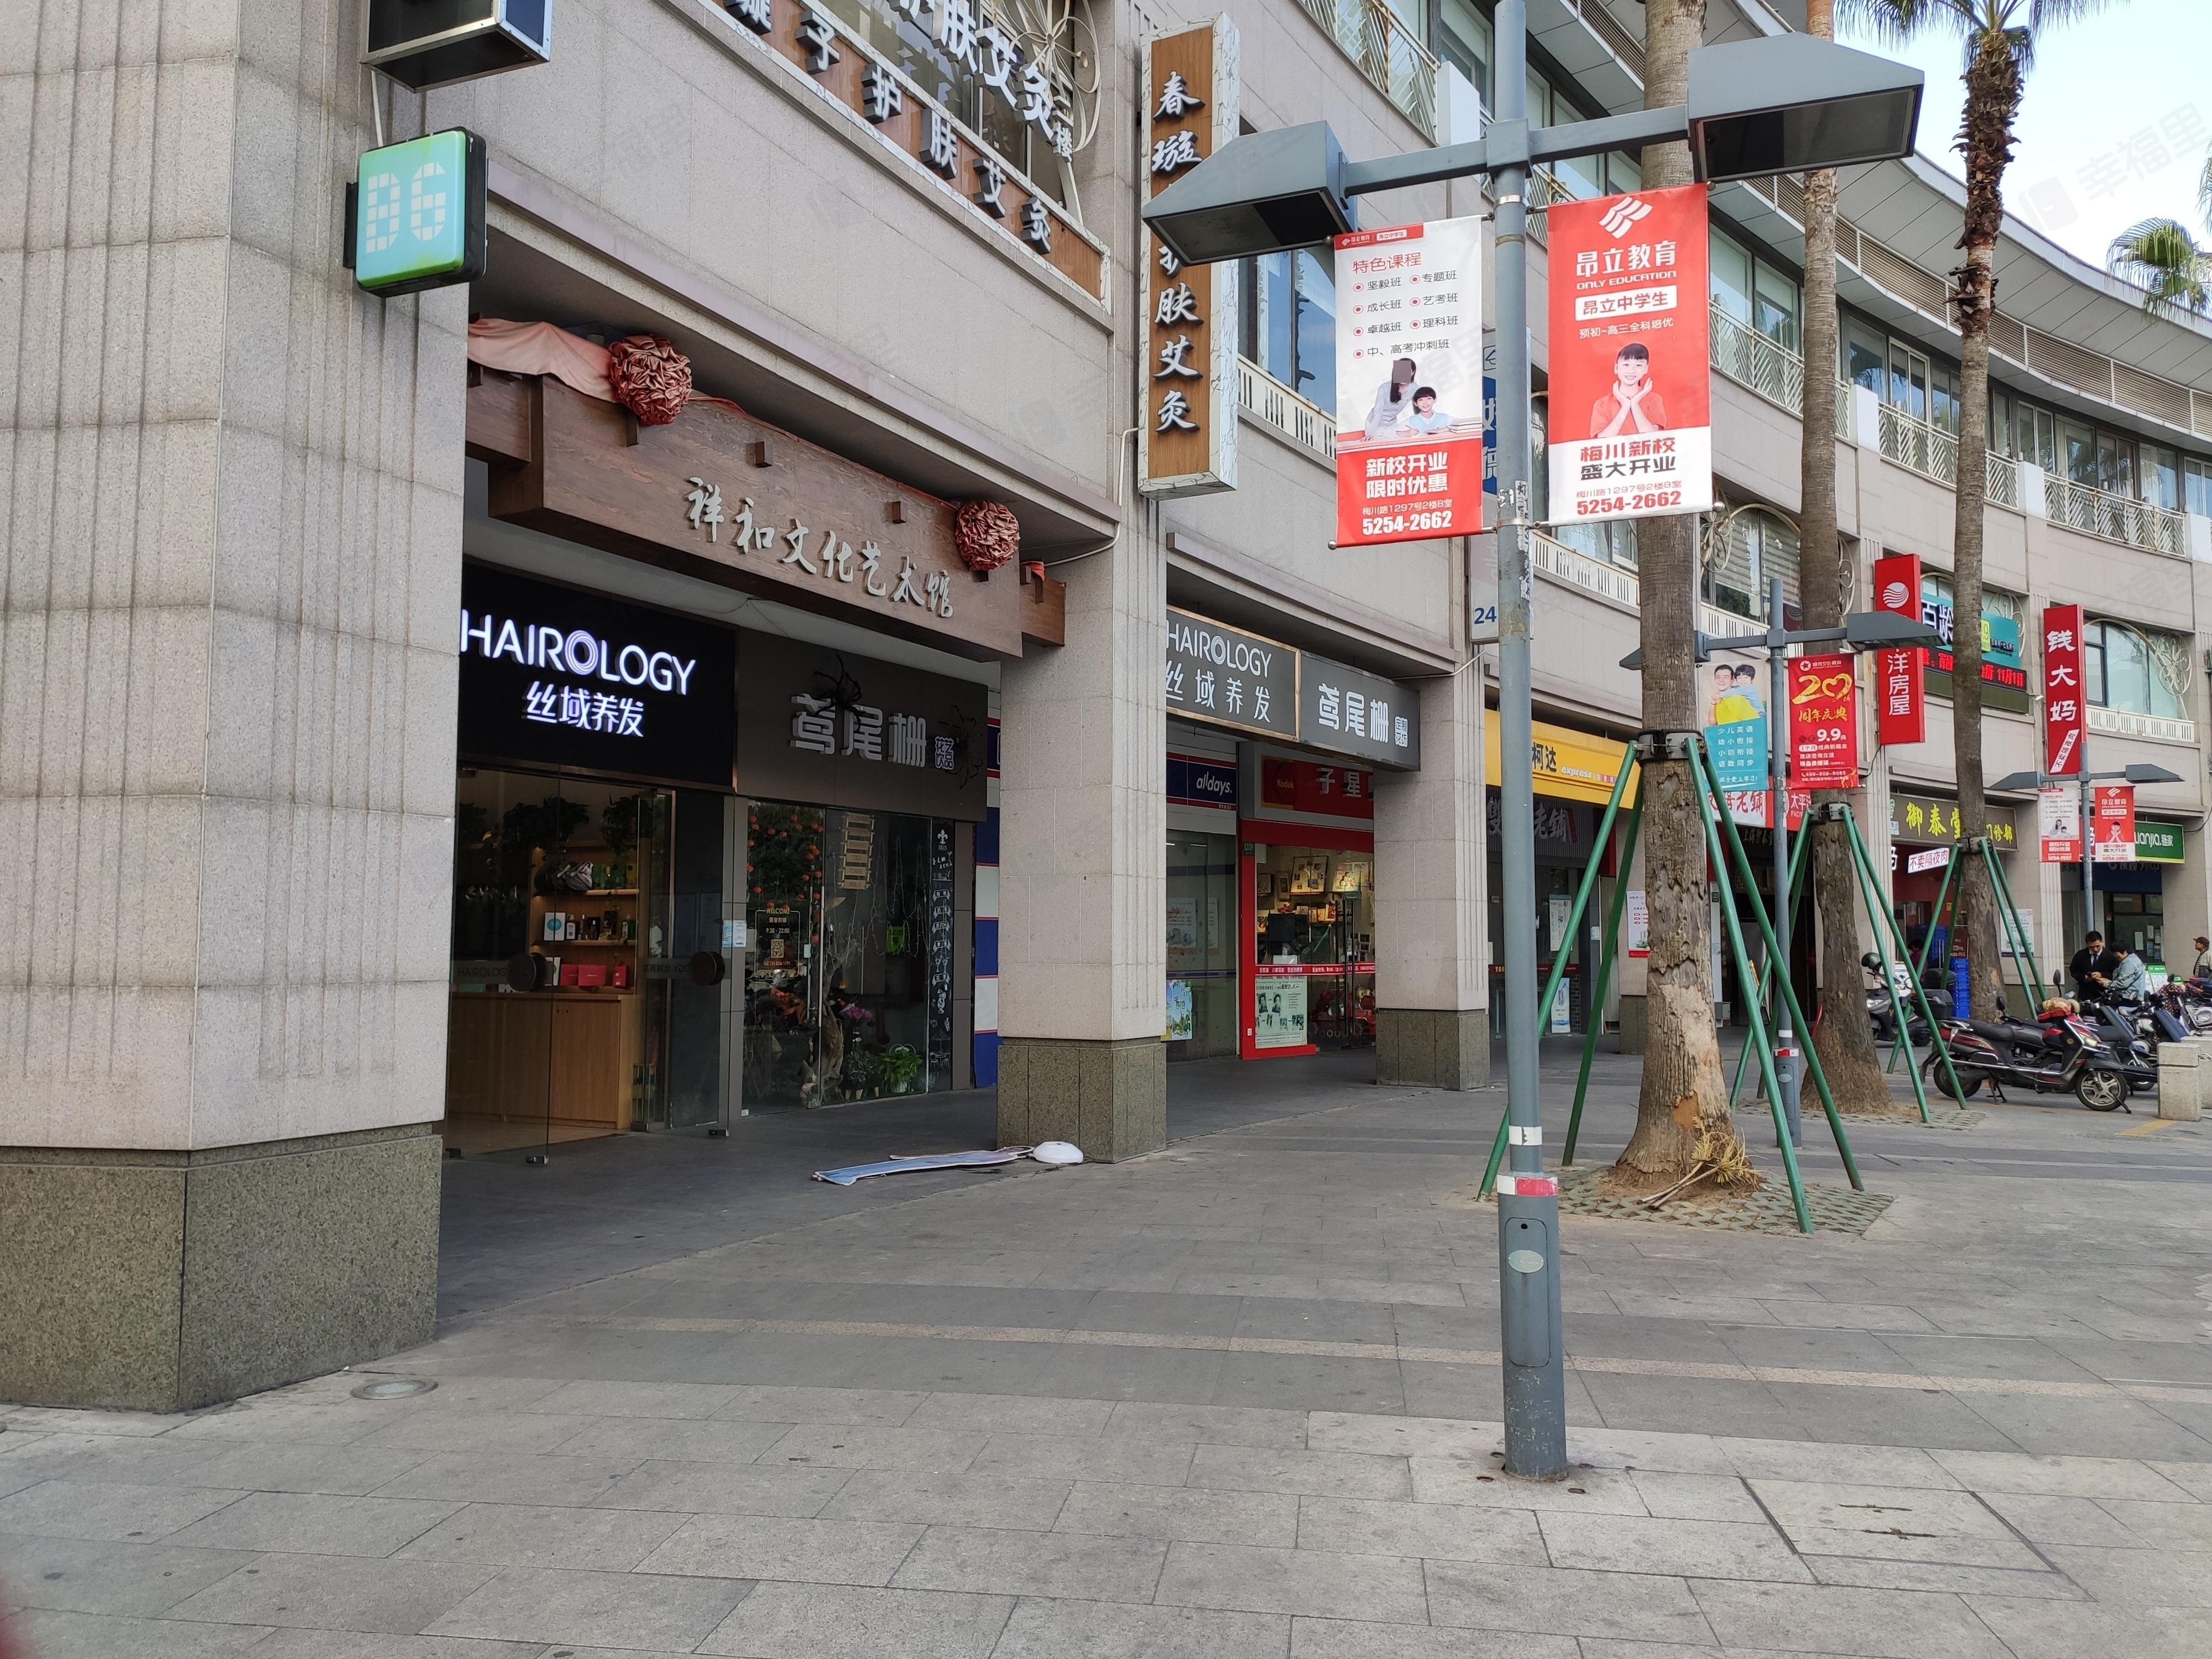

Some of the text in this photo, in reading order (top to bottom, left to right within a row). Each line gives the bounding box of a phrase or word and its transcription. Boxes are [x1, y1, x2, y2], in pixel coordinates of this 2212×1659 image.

[1152, 71, 1204, 434] 春璇肤艾灸
[1353, 251, 1421, 274] 特色课程
[1576, 241, 1676, 277] 昂立教育
[1367, 269, 1457, 291] 坚毅班 专题班
[1577, 270, 1677, 290] ONLY EDUCATION
[1367, 292, 1458, 313] 成长班 艺考班
[1583, 291, 1668, 316] 昂立中学生
[1367, 314, 1459, 335] 卓越班 理科班
[1368, 338, 1449, 357] 中、高考冲刺班
[1580, 437, 1676, 462] 梅川新校
[1366, 451, 1448, 478] 新校开业
[1580, 456, 1676, 481] 盛大开业
[1366, 472, 1448, 499] 限时优惠
[1576, 479, 1682, 498] 梅川路1297号2楼B室
[1362, 499, 1453, 515] 梅川路1297号2楼B室
[1577, 491, 1682, 515] 5254-2662
[1362, 510, 1452, 535] 5254-2662
[686, 477, 953, 617] 祥和文化艺术馆
[461, 609, 696, 695] HAIROLOGY
[1166, 619, 1272, 679] HAIROLOGY
[1887, 649, 1911, 716] 洋房屋
[2046, 629, 2077, 722] 钱大妈
[1165, 660, 1271, 723] 丝域养发
[525, 680, 644, 737] 丝域养发
[1318, 682, 1389, 743] 鸢尾栅
[1798, 708, 1848, 723] 周年庆典
[1718, 726, 1754, 734] 少儿英语
[1817, 728, 1847, 742] 9.9元
[1532, 742, 1557, 773] 柯达
[1719, 759, 1754, 768] 语数同步
[1277, 779, 1294, 790] Kodak
[1315, 767, 1374, 801] 子星
[1561, 766, 1592, 779] express
[1910, 849, 1948, 870] 不卖隔夜肉
